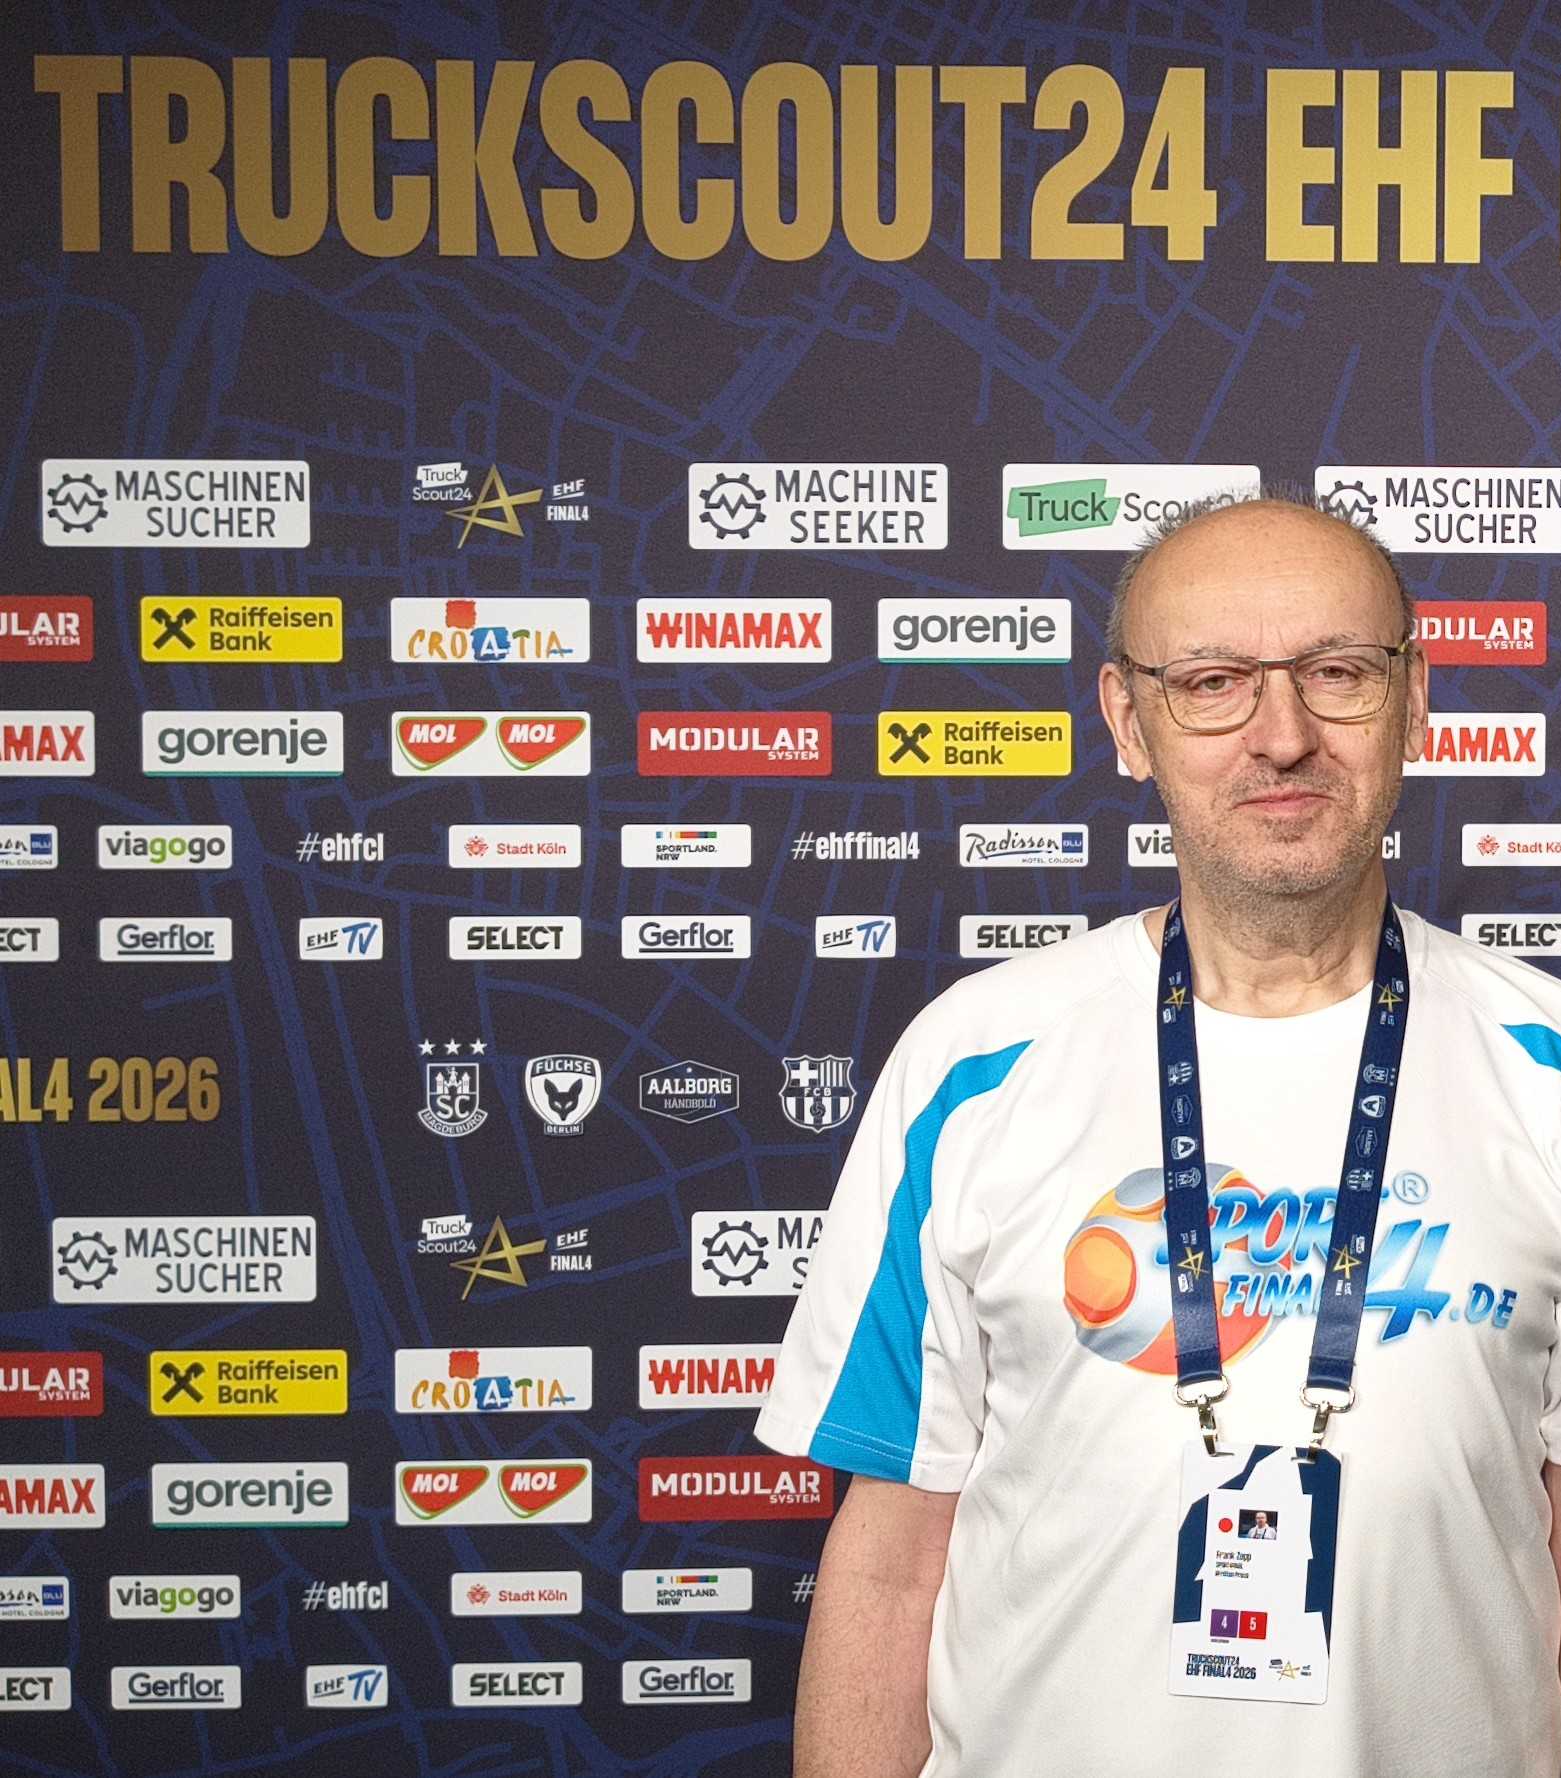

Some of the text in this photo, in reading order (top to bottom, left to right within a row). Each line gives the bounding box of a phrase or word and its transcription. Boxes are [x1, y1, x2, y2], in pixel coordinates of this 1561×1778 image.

[34, 55, 1218, 262] TRUCKSCOUT24
[1266, 68, 1514, 263] EHF
[115, 470, 305, 502] MASCHINEN
[422, 467, 463, 482] Truck
[775, 469, 937, 503] MACHINE
[412, 486, 473, 501] Scout24
[552, 479, 586, 496] EHF
[547, 505, 589, 521] FINAL4
[1020, 492, 1108, 523] Truck
[146, 507, 275, 538] SUCHER
[790, 511, 925, 543] SEEKER
[1415, 513, 1537, 544] SUCHER
[209, 607, 333, 629] Raiffeisen
[893, 605, 1056, 651] gorenje
[27, 636, 80, 646] SYSTEM
[210, 631, 272, 651] Bank
[646, 612, 822, 649] WINAMAX
[408, 628, 573, 660] CROATIA
[1484, 641, 1534, 649] SYSTEM
[158, 718, 327, 763] gorenje
[408, 724, 556, 744] MOL MOL
[649, 727, 819, 752] MODULAR
[944, 722, 1062, 743] Raiffeisen
[767, 750, 819, 760] SYSTEM
[944, 745, 1003, 765] Bank
[106, 831, 225, 862] viagogo
[297, 832, 383, 861] #ehfcl
[496, 841, 566, 855] Stadt Köln
[792, 832, 920, 860] #ehffinal4
[966, 829, 1082, 863] Radisson BLU
[1507, 842, 1540, 854] Stadt
[306, 923, 378, 954] EHF TV
[467, 926, 564, 950] SELECT
[822, 920, 888, 952] EHF TV
[535, 1057, 591, 1074] FÜCHSE
[89, 1057, 220, 1123] 2026
[648, 1078, 731, 1096] AALBORG
[436, 1094, 470, 1118] SC
[423, 1109, 483, 1135] MAGDEBURG
[545, 1125, 581, 1134] BERLIN
[427, 1220, 466, 1235] Truck
[556, 1229, 589, 1247] EHF
[124, 1227, 311, 1258] MASCHINEN
[417, 1239, 477, 1254] Scout24
[550, 1256, 592, 1271] FINAL4
[156, 1264, 281, 1293] SUCHER
[218, 1361, 338, 1381] Raiffeisen
[38, 1392, 90, 1400] SYSTEM
[218, 1385, 278, 1403] Bank
[412, 1378, 575, 1409] CROATIA
[167, 1471, 332, 1514] gorenje
[411, 1471, 557, 1492] MOL MOL
[652, 1471, 821, 1496] MODULAR
[769, 1495, 821, 1503] SYSTEM
[116, 1581, 233, 1612] viagogo
[302, 1581, 388, 1610] #ehfcl
[498, 1589, 567, 1602] Stadt Köln
[1221, 1615, 1227, 1629] 4
[470, 1672, 564, 1696] SELECT
[1233, 1666, 1256, 1680] 2026
[314, 1671, 382, 1701] EHF TV
